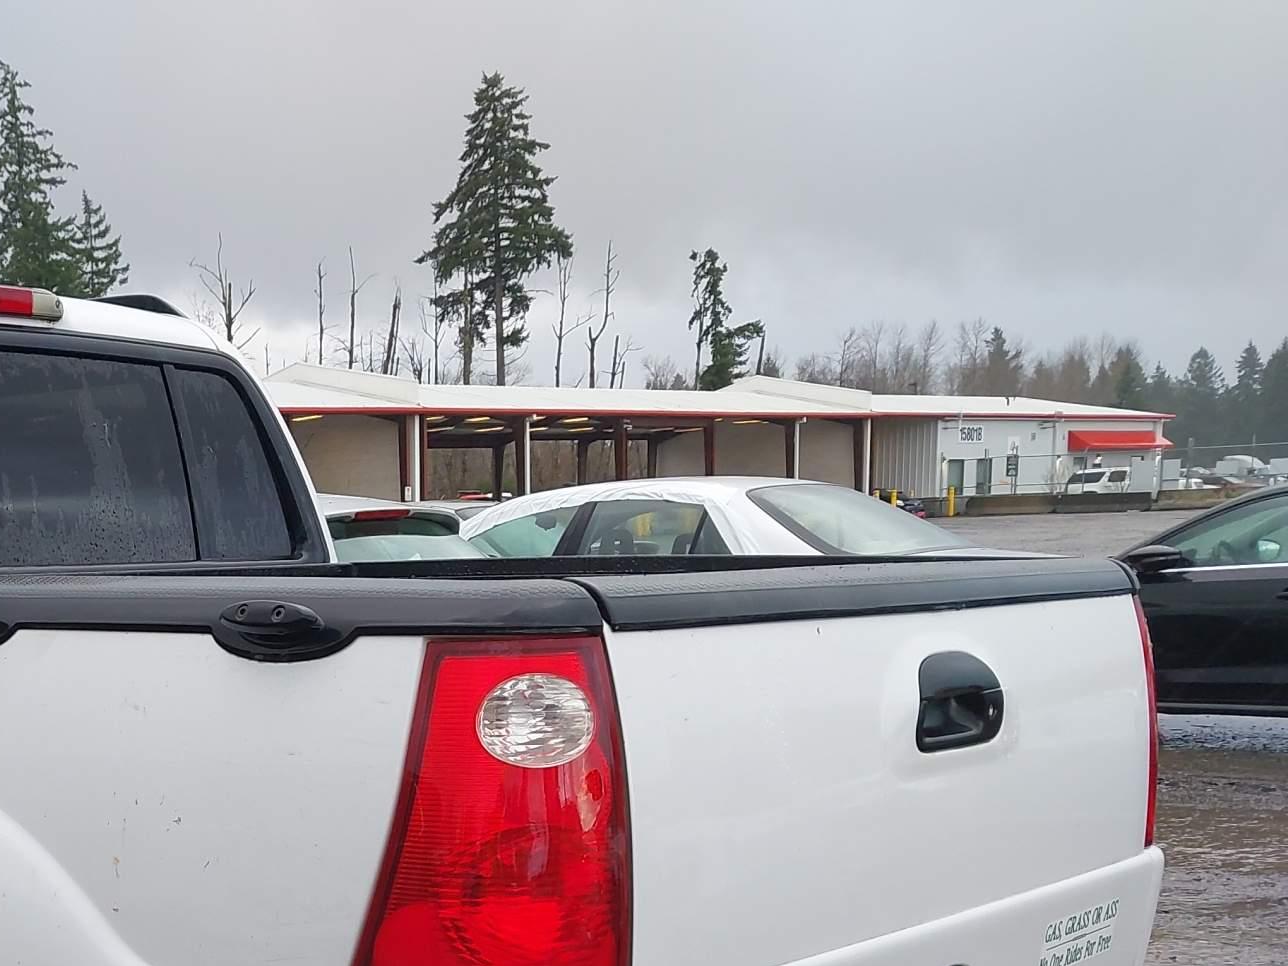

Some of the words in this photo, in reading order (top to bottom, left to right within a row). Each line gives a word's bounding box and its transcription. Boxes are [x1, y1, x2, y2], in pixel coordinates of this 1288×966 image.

[1065, 910, 1091, 936] GRASS
[1092, 906, 1103, 925] OR
[1103, 899, 1119, 921] ASS
[1064, 944, 1083, 966] Rides
[1084, 940, 1096, 959] For
[1096, 935, 1112, 953] Free
